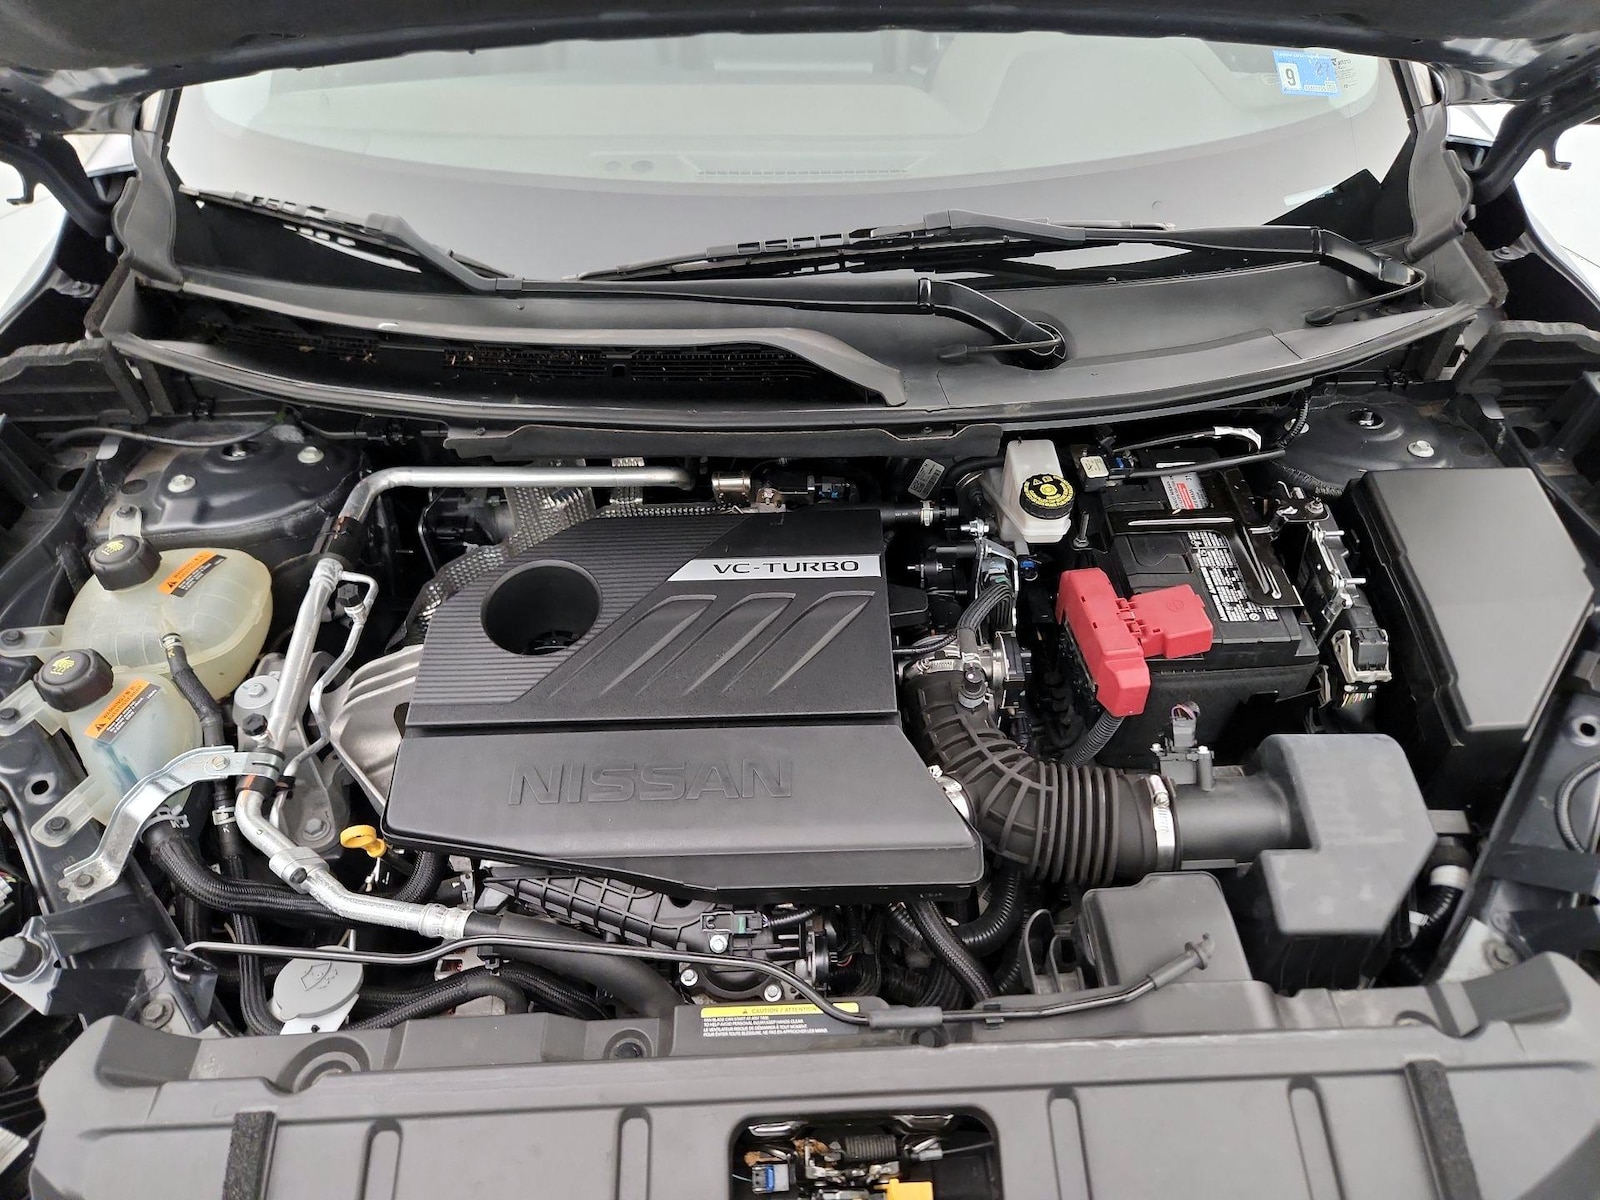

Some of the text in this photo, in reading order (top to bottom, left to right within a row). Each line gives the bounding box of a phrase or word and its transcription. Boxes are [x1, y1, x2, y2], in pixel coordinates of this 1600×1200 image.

[1285, 68, 1296, 86] 9
[713, 560, 859, 574] VC-TURBO
[507, 760, 792, 805] NISSAN
